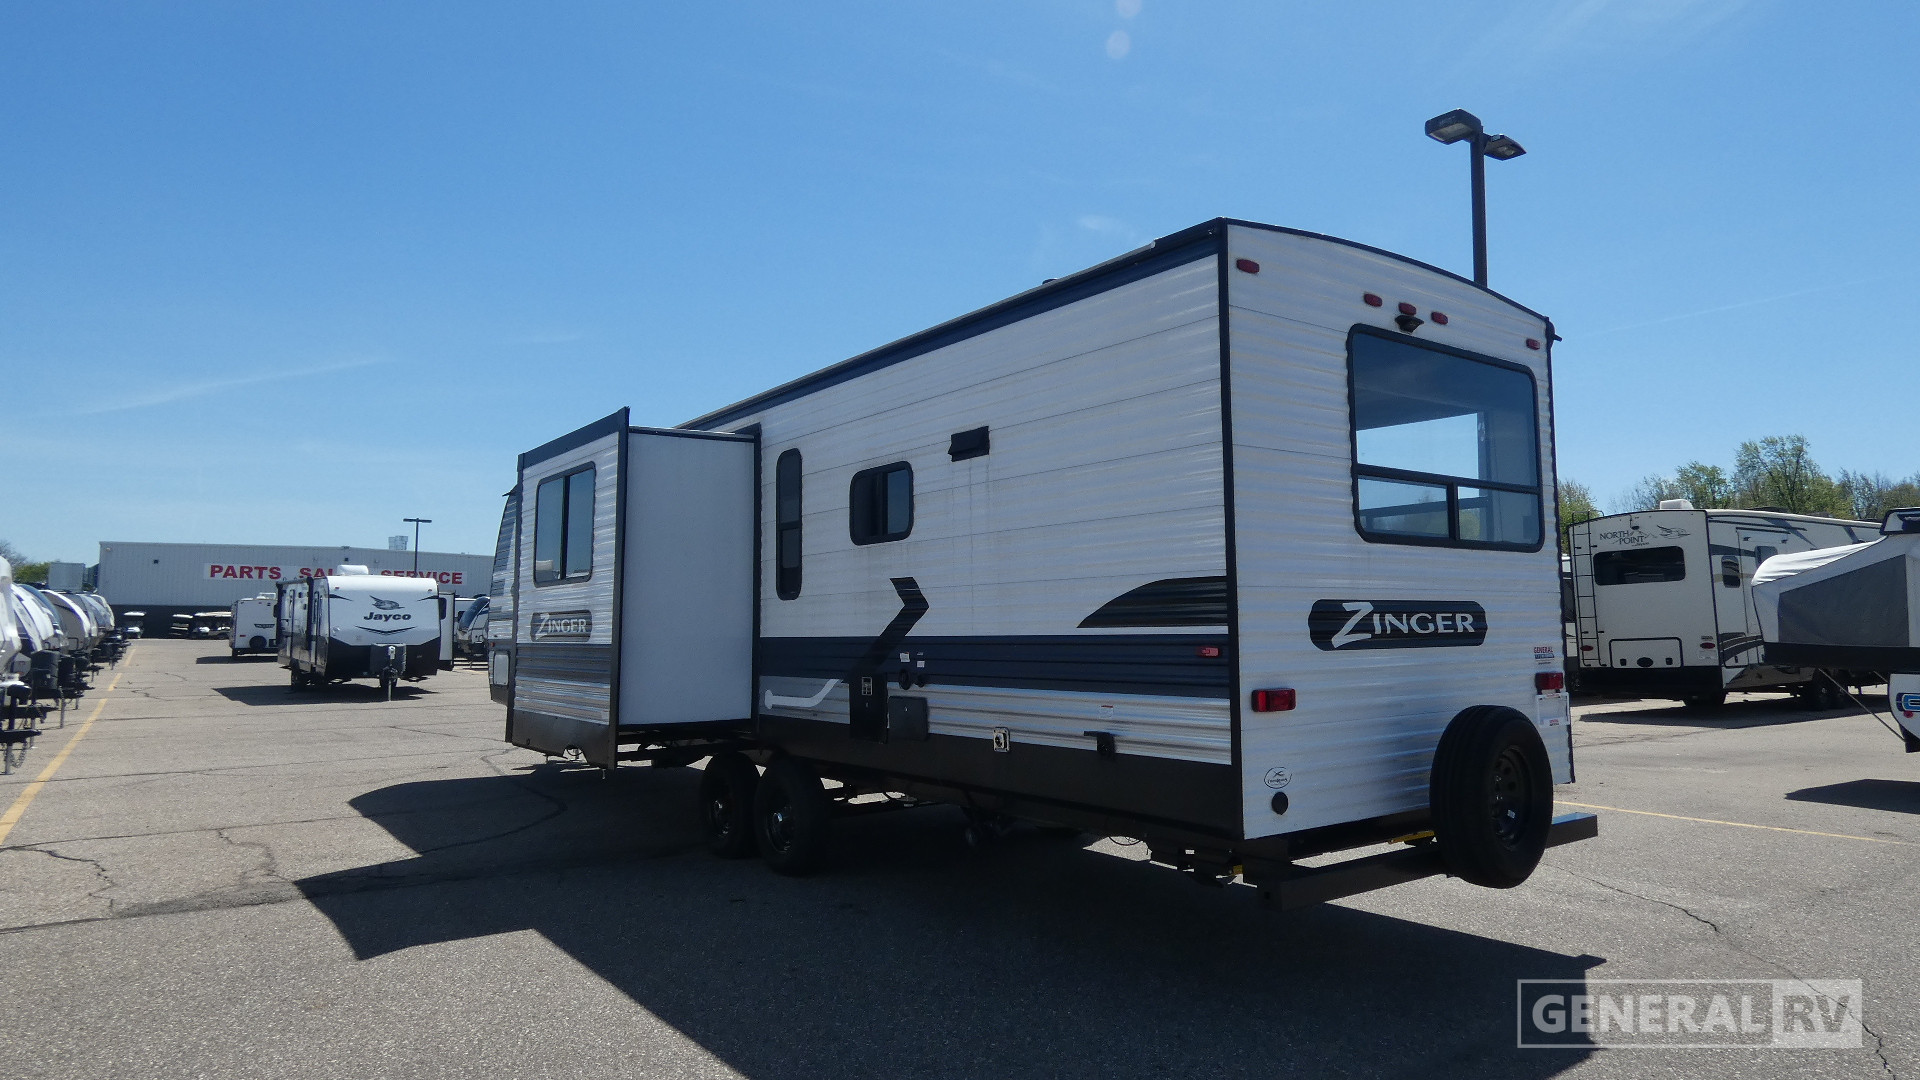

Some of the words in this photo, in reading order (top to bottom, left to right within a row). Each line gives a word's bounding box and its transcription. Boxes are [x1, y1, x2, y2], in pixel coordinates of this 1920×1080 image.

[1600, 530, 1629, 541] NORTH
[1619, 535, 1645, 545] POINT
[210, 565, 281, 580] PARTS
[363, 612, 412, 622] Jayco
[534, 612, 587, 641] ZINGER
[1331, 601, 1475, 649] ZINGER
